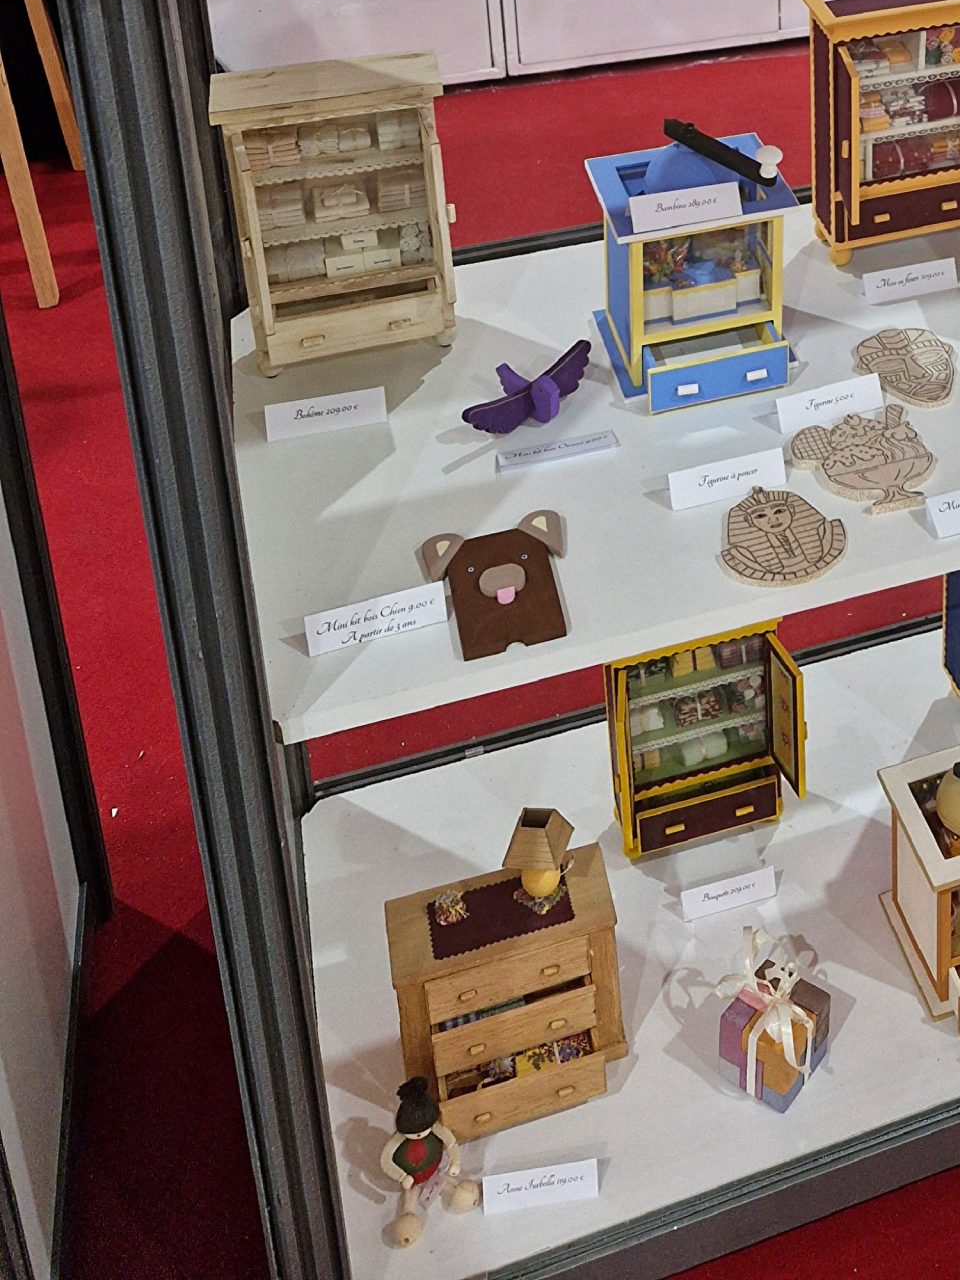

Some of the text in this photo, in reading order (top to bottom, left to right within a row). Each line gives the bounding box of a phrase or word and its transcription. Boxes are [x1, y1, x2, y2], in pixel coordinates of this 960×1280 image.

[294, 405, 324, 420] Bohème
[698, 474, 729, 488] Figurine
[316, 620, 349, 636] Mini
[350, 612, 361, 626] kit
[363, 608, 378, 624] bois
[380, 602, 406, 619] Chien
[358, 628, 382, 643] partir
[384, 618, 394, 633] de
[402, 620, 416, 628] ans
